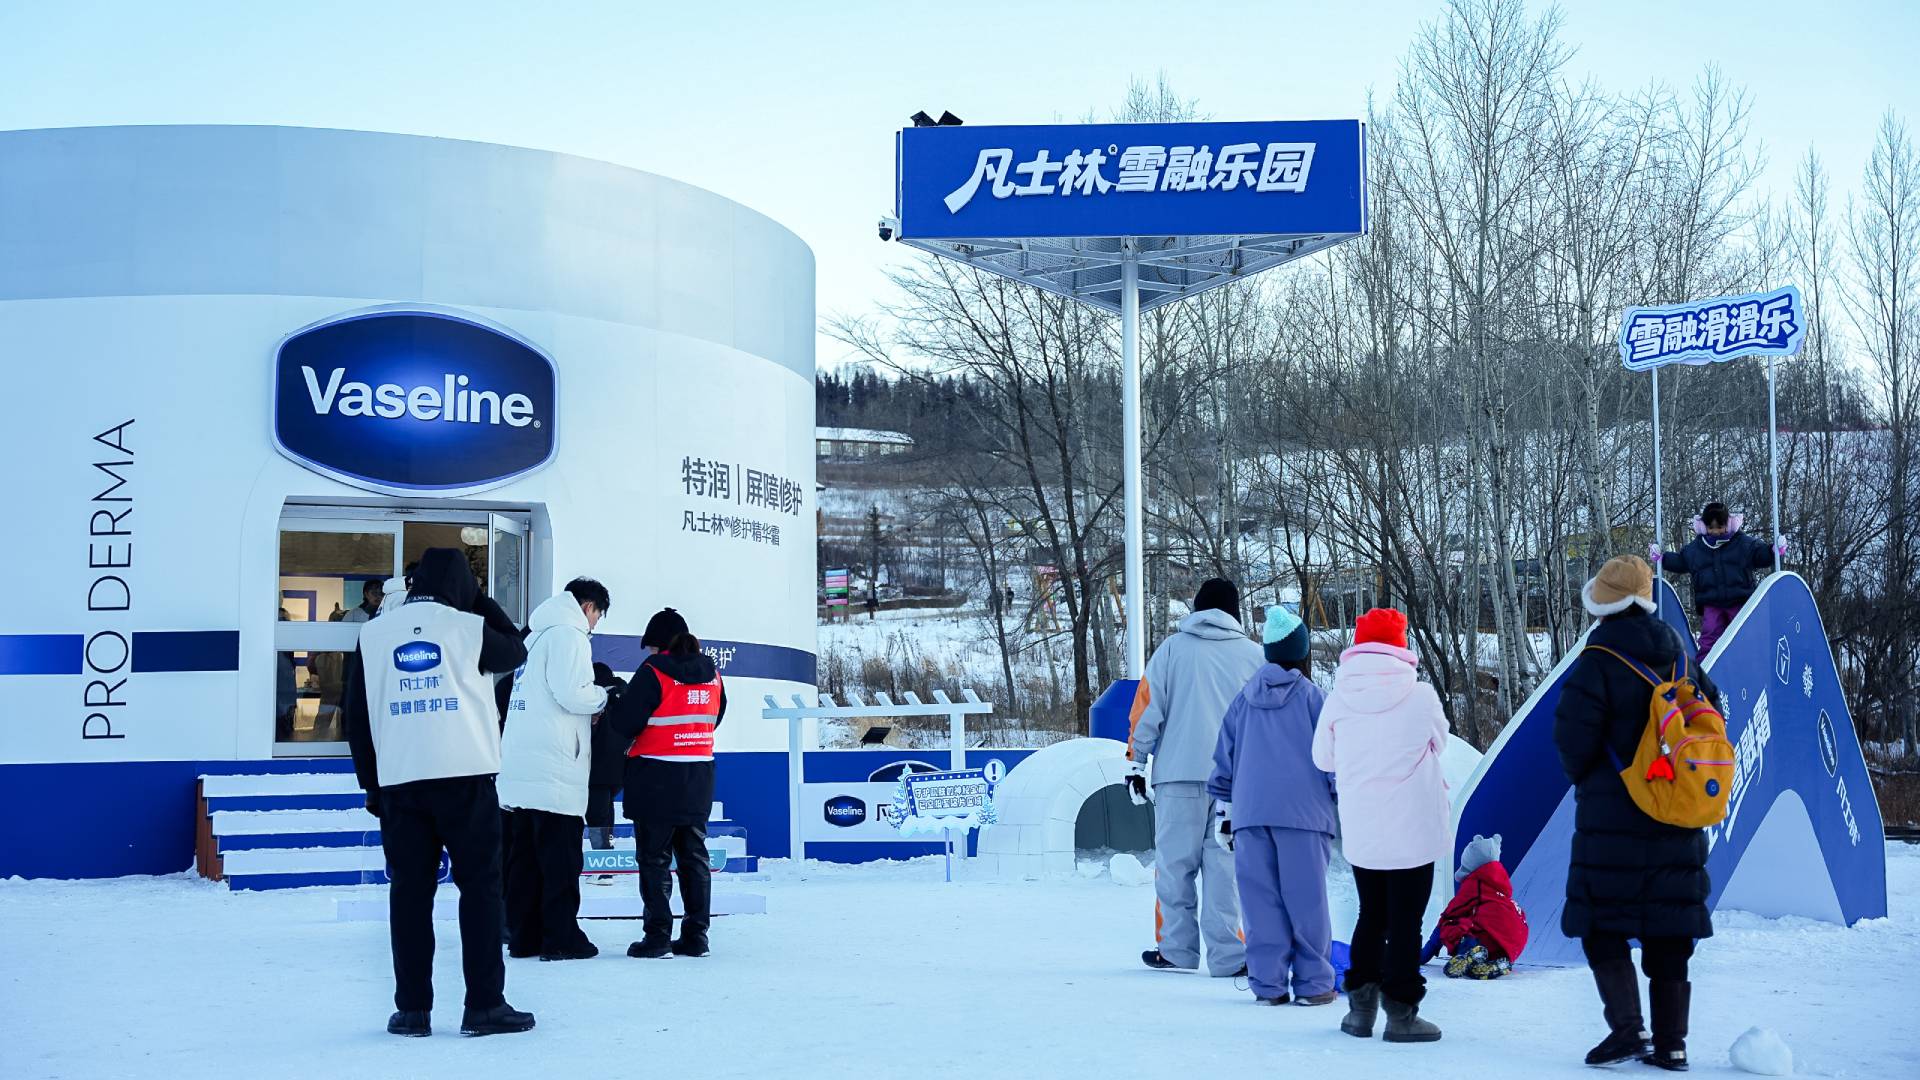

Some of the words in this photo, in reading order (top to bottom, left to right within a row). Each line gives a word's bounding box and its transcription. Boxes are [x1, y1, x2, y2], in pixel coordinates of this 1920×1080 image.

[1629, 297, 1795, 360] 雪融滑滑乐
[88, 418, 135, 611] DERMA
[397, 651, 438, 663] Vaseline
[82, 630, 129, 740] PRO
[687, 689, 711, 705] 摄影
[389, 697, 458, 716] 雪融修护官
[827, 805, 864, 817] Vaseline
[587, 855, 637, 868] wats
